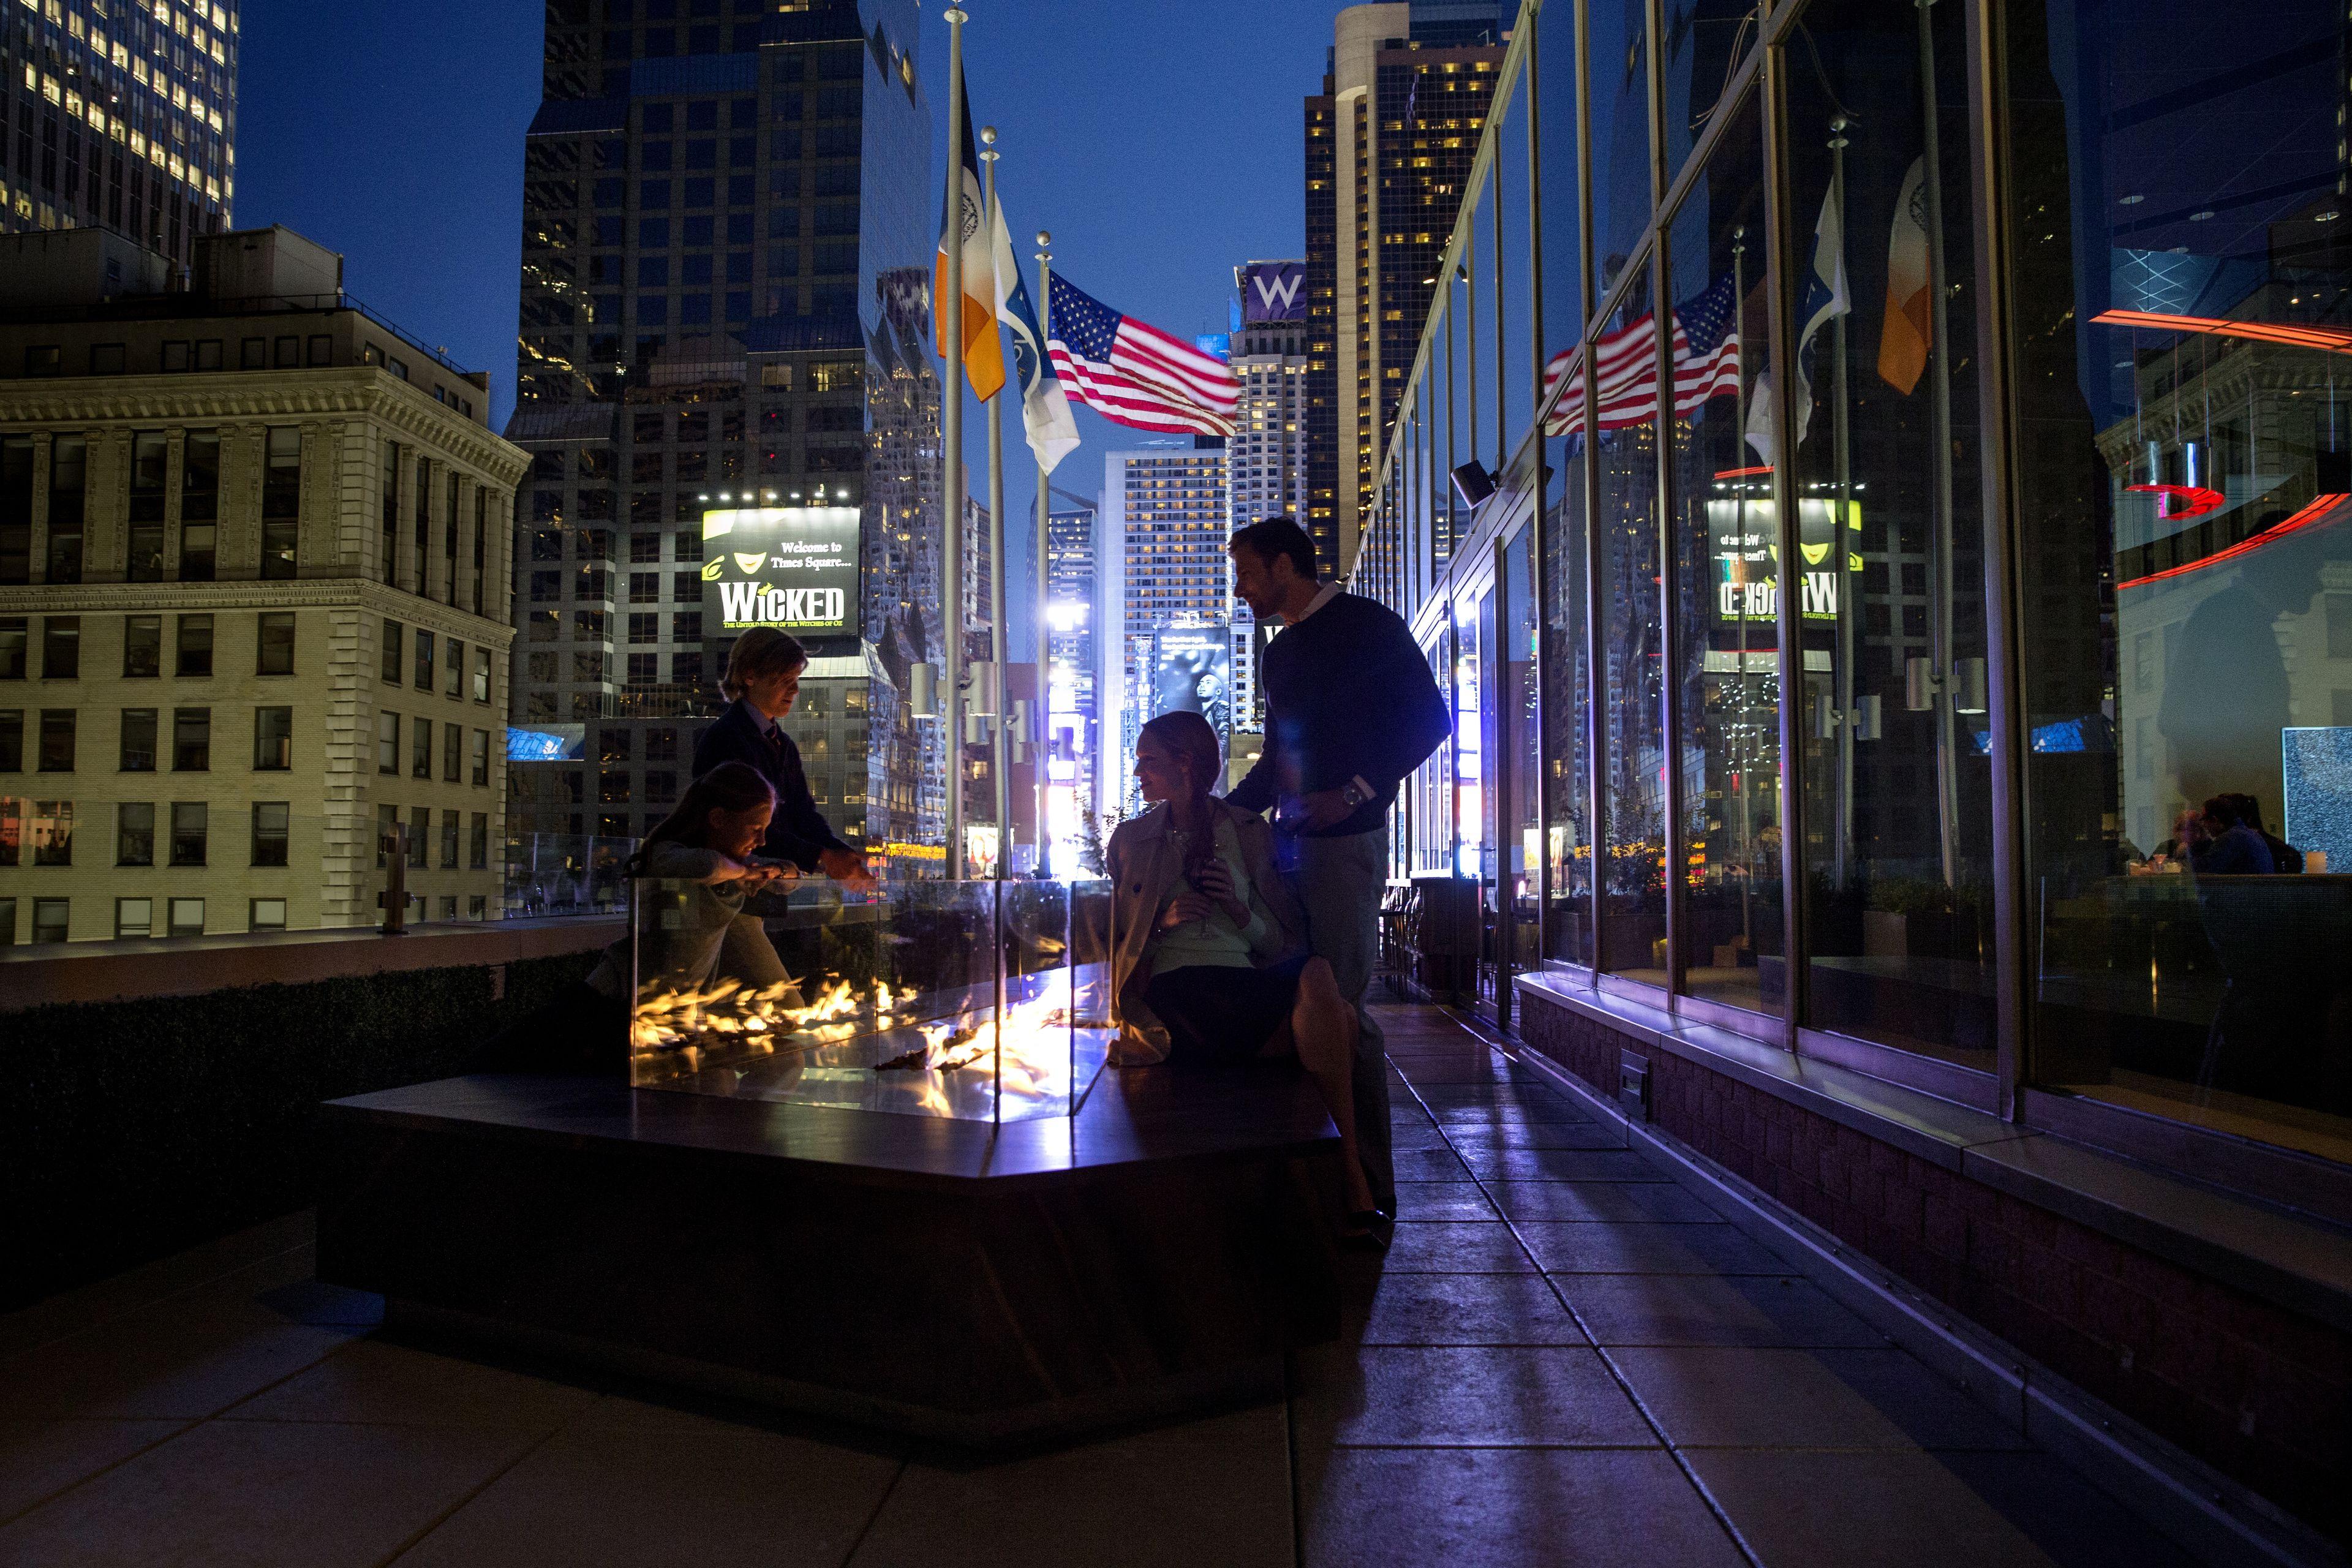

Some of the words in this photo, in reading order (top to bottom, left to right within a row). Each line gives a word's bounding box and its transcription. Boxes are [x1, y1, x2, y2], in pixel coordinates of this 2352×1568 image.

[1253, 275, 1303, 311] W
[782, 540, 829, 553] Welcome
[831, 542, 842, 552] to
[771, 557, 803, 568] Times
[805, 556, 852, 571] Square...
[1137, 657, 1150, 725] TIMES
